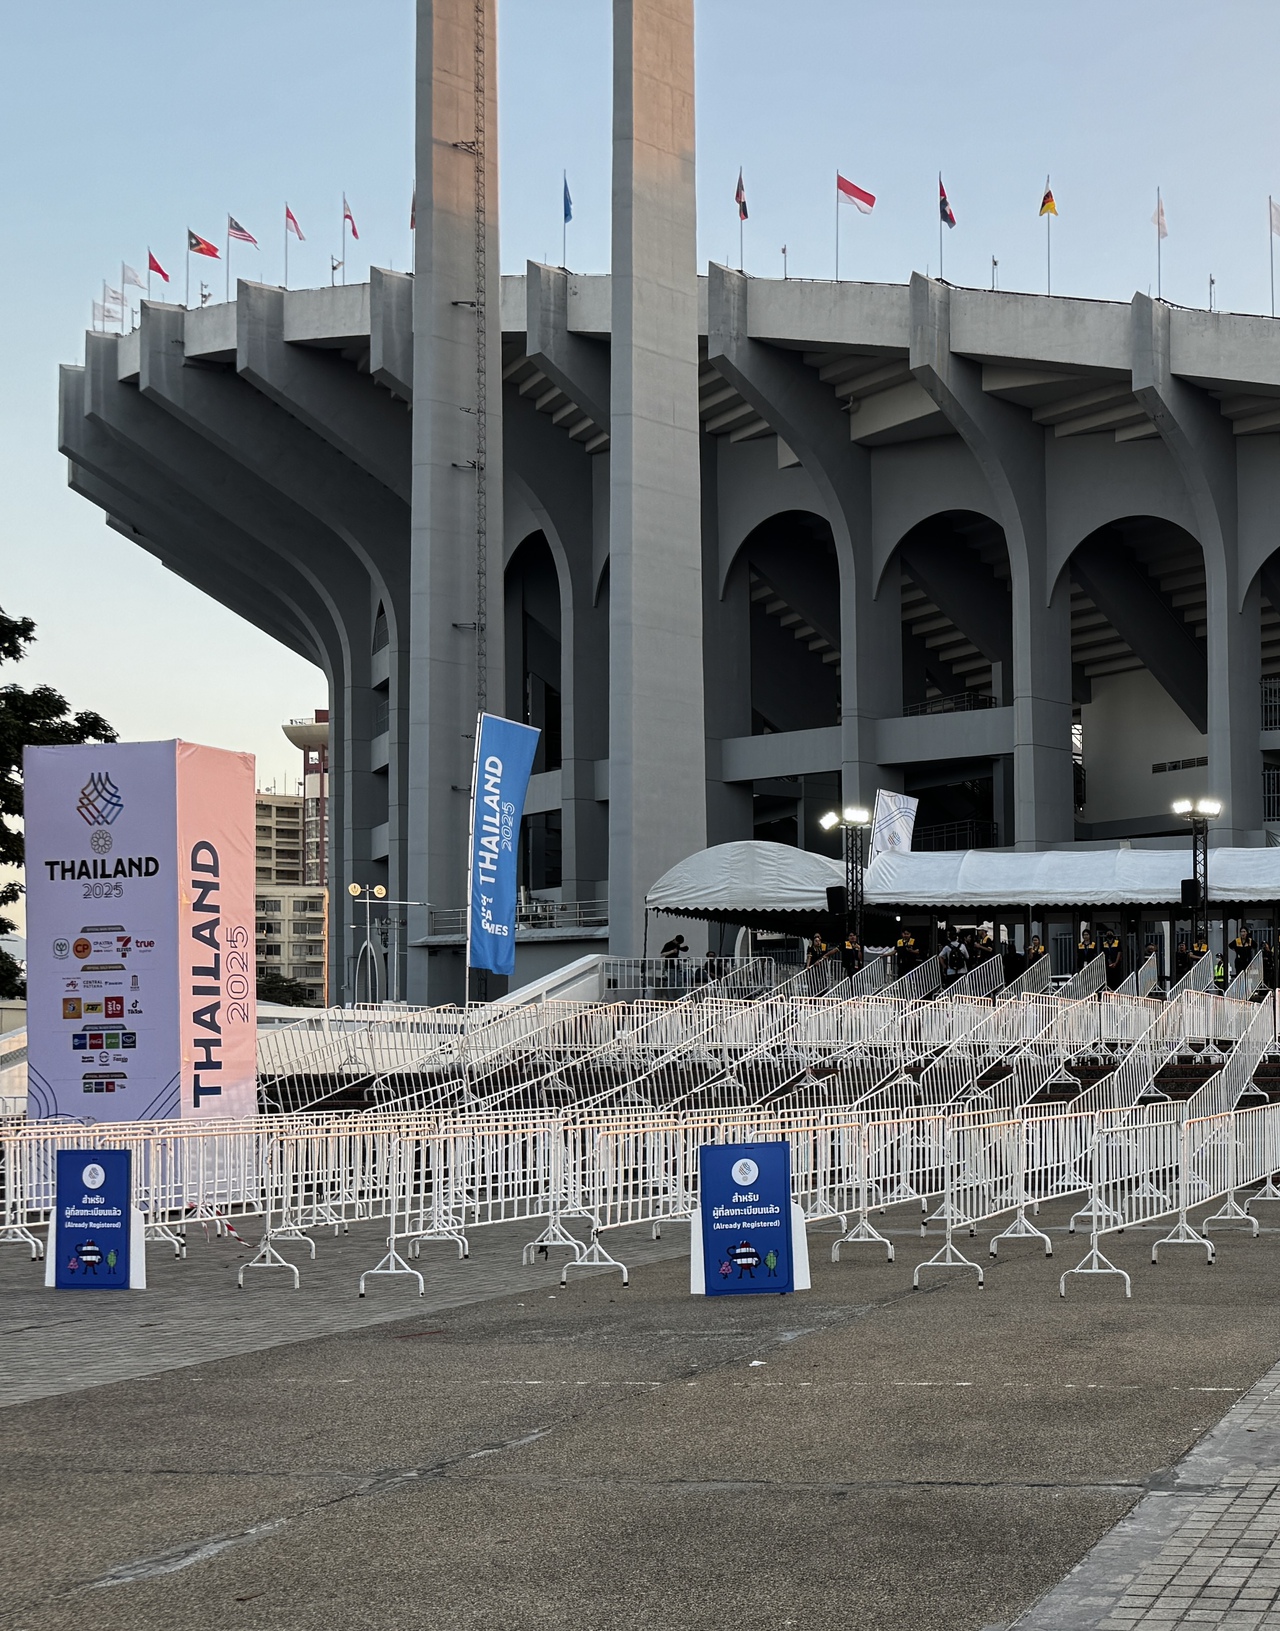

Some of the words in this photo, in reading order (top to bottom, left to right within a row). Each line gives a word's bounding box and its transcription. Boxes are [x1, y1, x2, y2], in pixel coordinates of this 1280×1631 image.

[479, 755, 503, 885] THAILAND
[501, 801, 515, 852] 2025
[45, 857, 159, 881] THAILAND
[83, 882, 123, 898] 2025
[75, 944, 89, 953] CP
[135, 940, 155, 948] true
[191, 840, 223, 1108] THAILAND
[226, 926, 249, 1024] 2025
[82, 1194, 105, 1204] สำหรับ
[732, 1192, 759, 1203] สำหรับ
[712, 1205, 780, 1219] ผู้ที่ลงทะเบียนแล้ว
[65, 1221, 88, 1229] (Already
[89, 1221, 121, 1229] Registered)
[713, 1221, 741, 1230] (Already
[742, 1219, 780, 1229] Registered)
